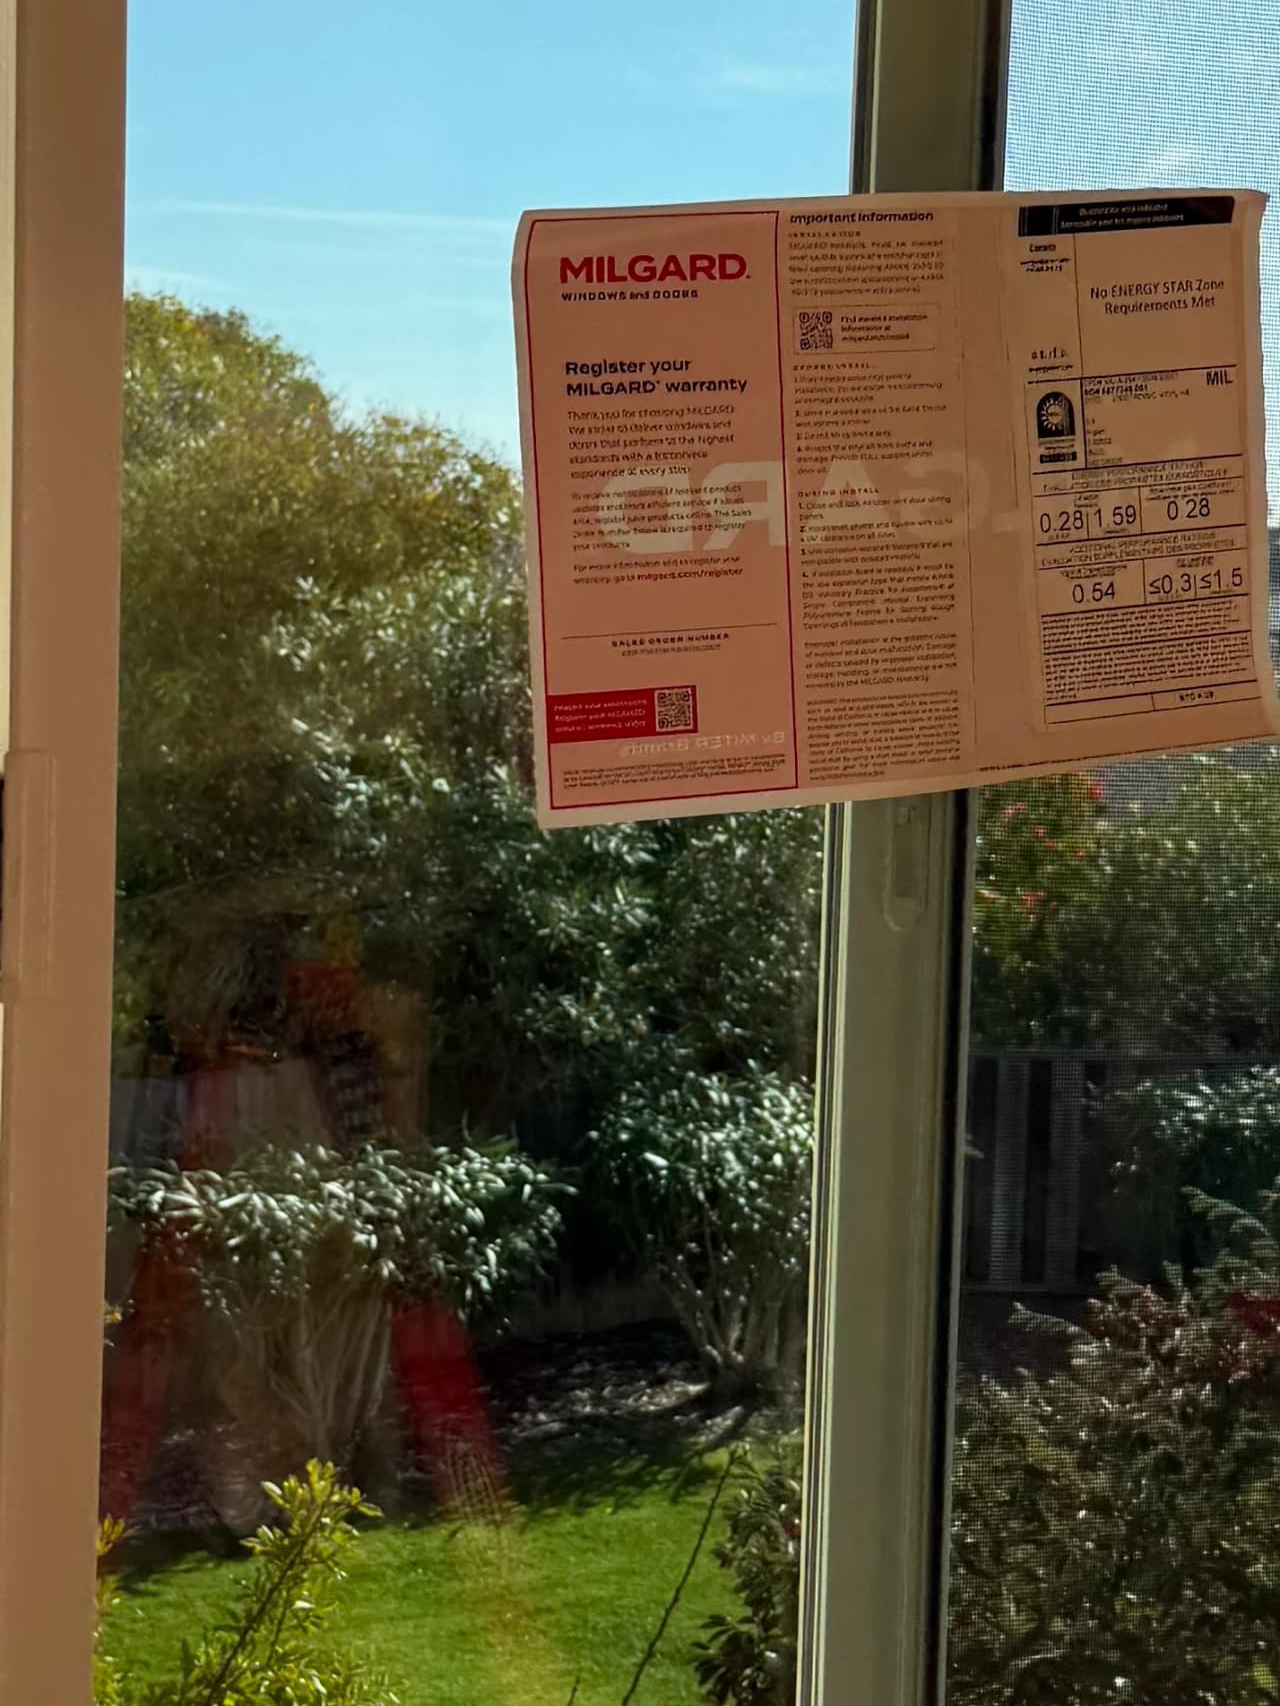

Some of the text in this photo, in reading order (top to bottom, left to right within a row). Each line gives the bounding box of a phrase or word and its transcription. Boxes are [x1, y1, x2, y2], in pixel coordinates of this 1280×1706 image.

[790, 213, 856, 225] Important
[560, 254, 747, 284] MILGARD
[1111, 282, 1159, 298] ENERGY
[1163, 280, 1192, 292] STAR
[1196, 279, 1224, 291] Zone
[1105, 297, 1215, 316] Requirements Met
[565, 359, 691, 377] Register your
[1206, 369, 1233, 386] MIL
[665, 379, 747, 393] warranty
[1166, 497, 1210, 520] 0.28
[1040, 504, 1137, 533] 0.28 1.59
[1072, 581, 1116, 604] 0.54
